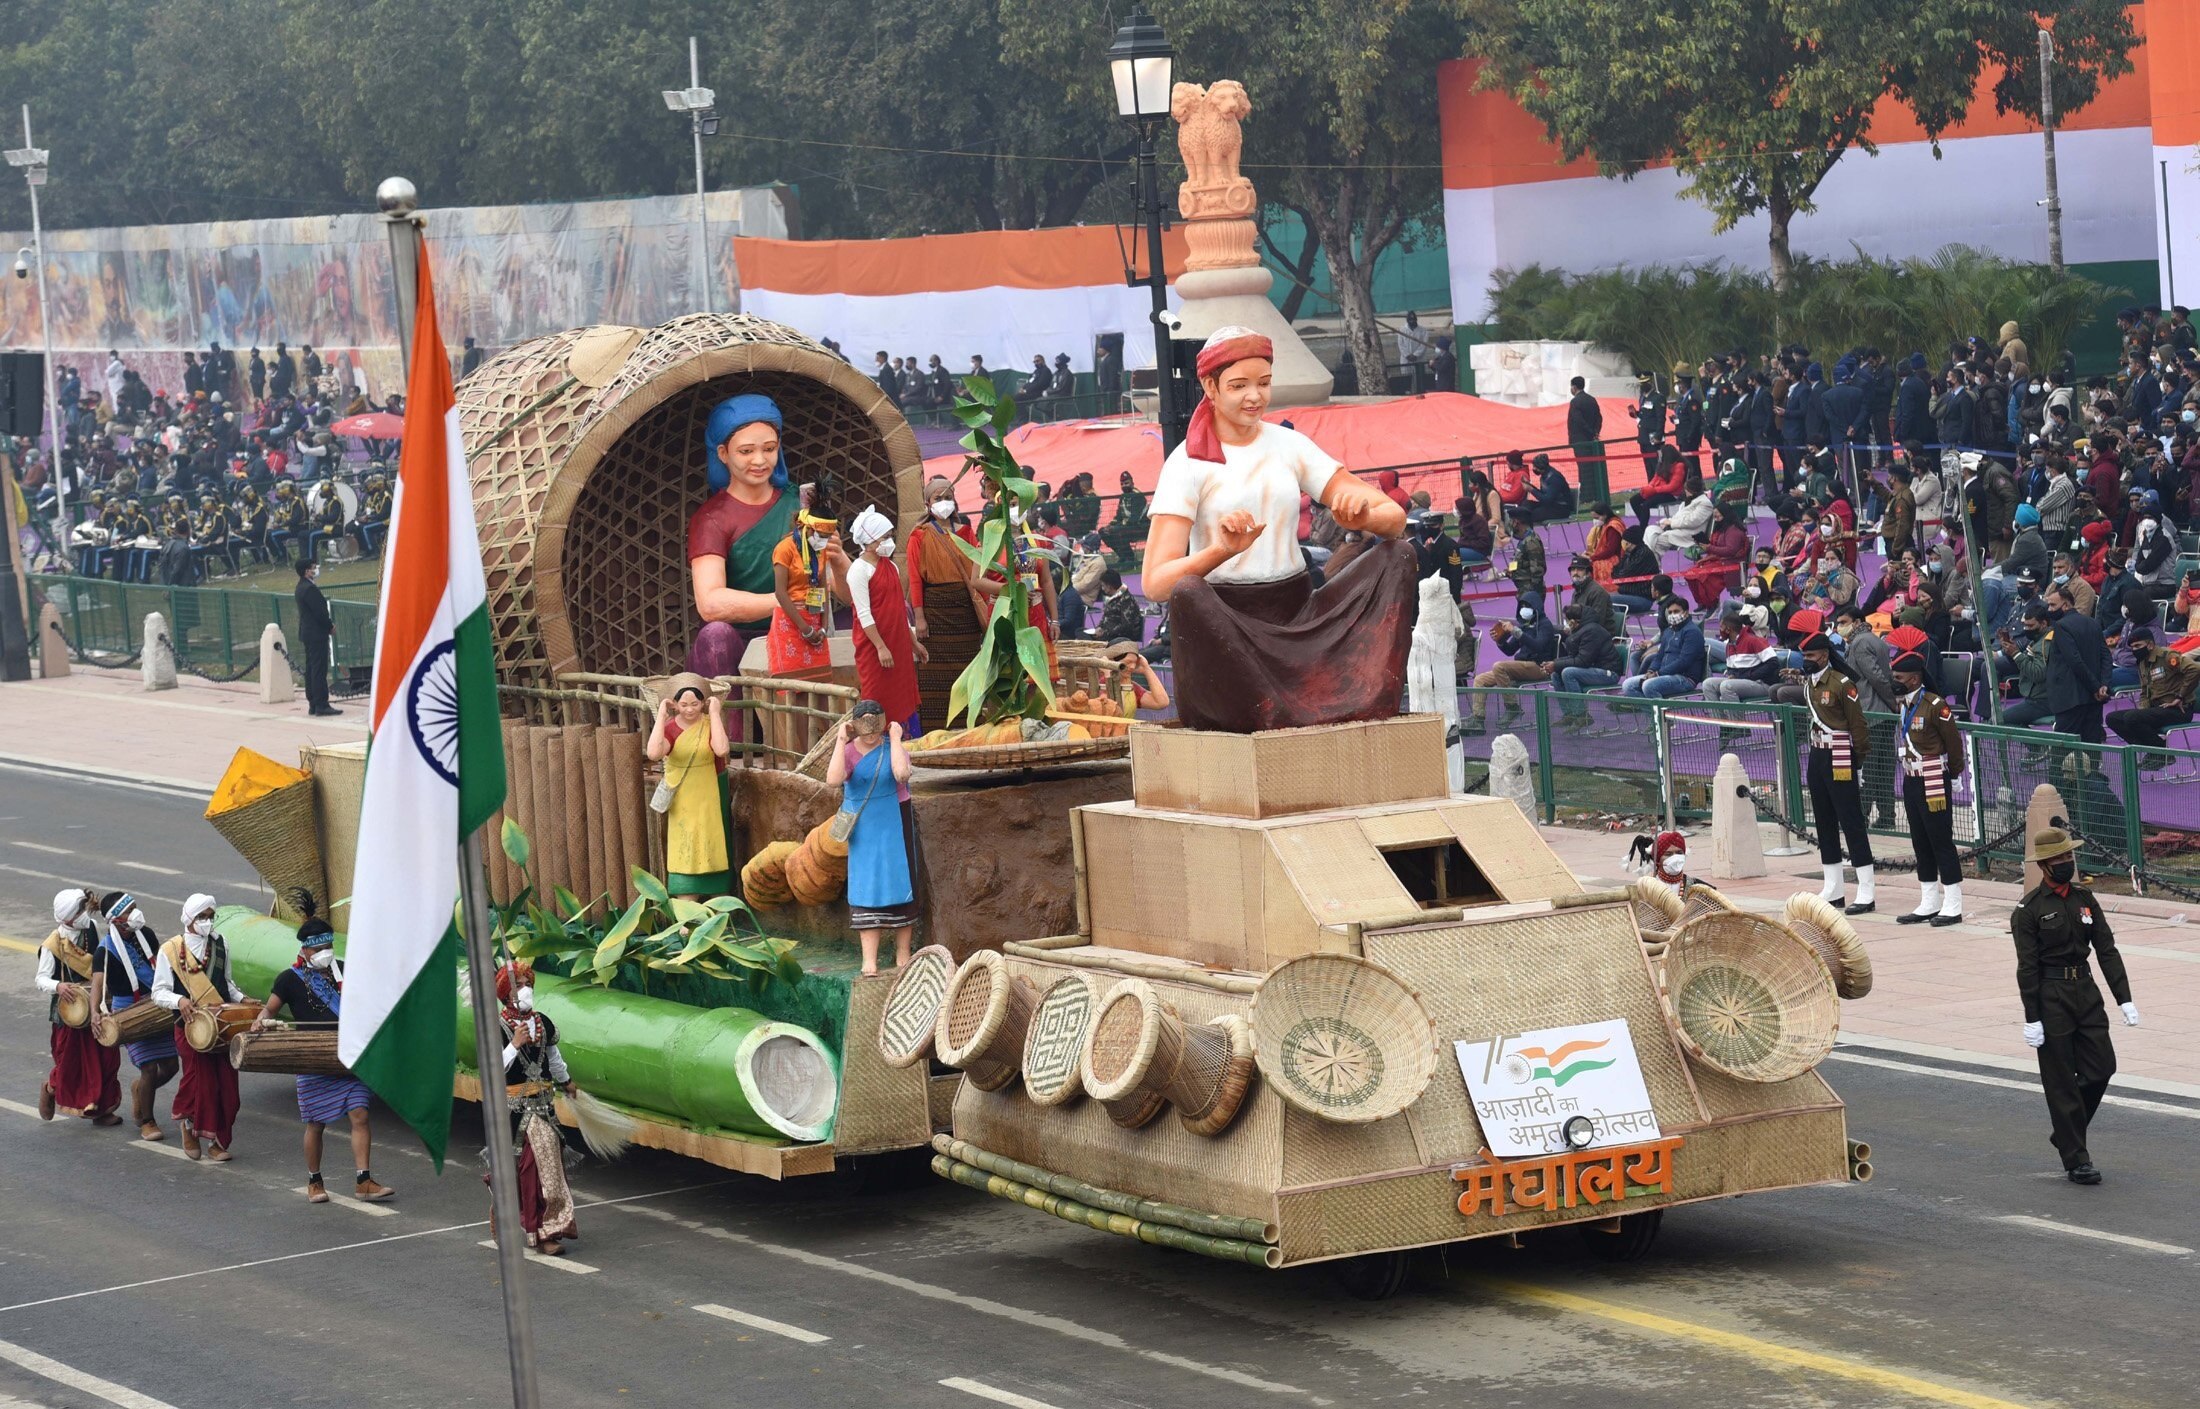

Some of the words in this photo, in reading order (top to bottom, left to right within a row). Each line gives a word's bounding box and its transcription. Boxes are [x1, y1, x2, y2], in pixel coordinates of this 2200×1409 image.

[1476, 1086, 1556, 1122] आज़ादी
[1557, 1097, 1579, 1112] का
[1509, 1122, 1564, 1152] अमृत
[1587, 1104, 1655, 1141] होत्सव
[1451, 1135, 1684, 1216] मेघालय
